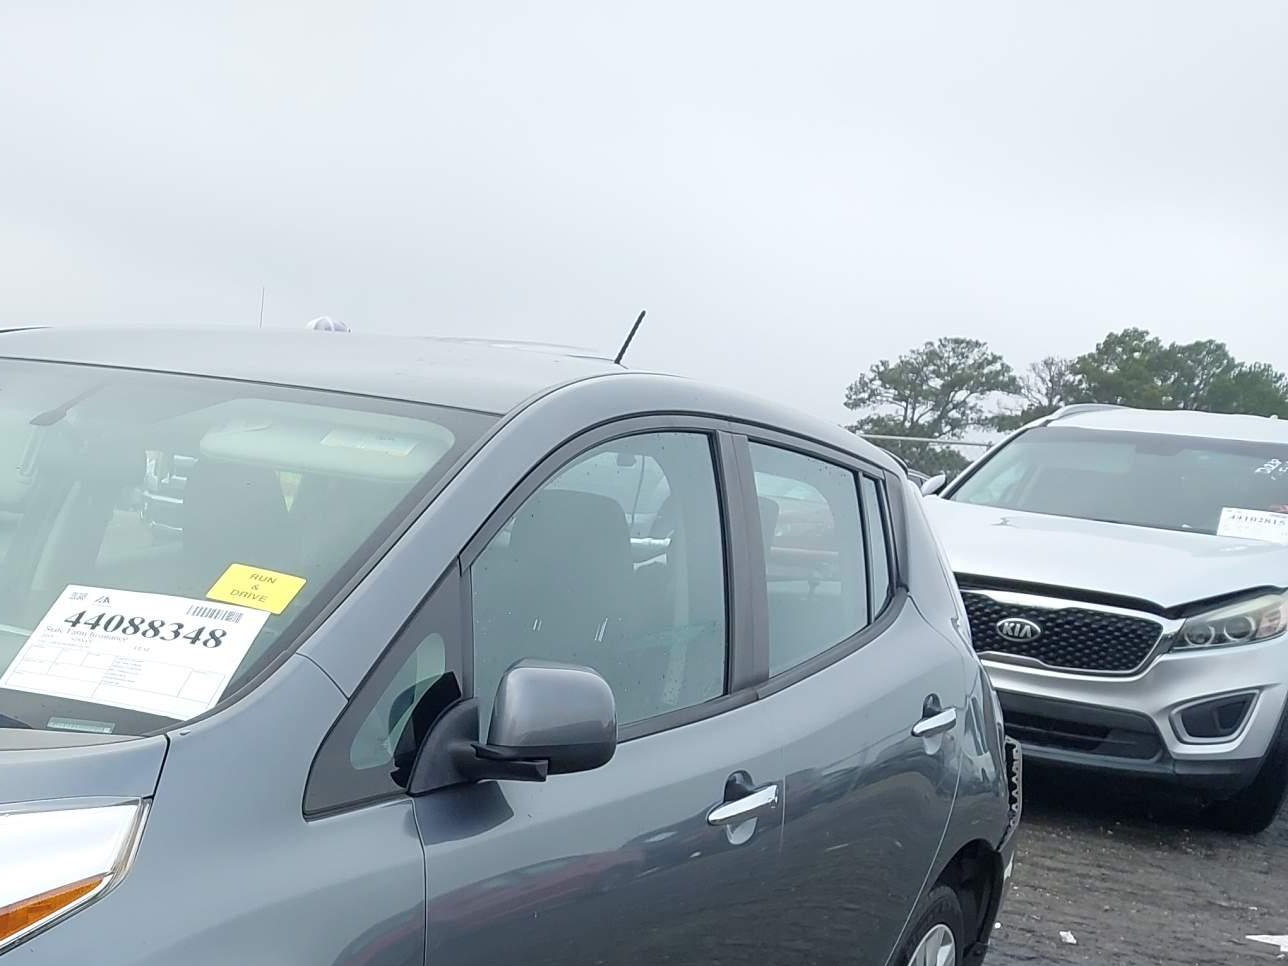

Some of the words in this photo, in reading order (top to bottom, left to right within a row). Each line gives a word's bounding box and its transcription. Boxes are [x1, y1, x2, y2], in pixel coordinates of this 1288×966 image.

[249, 573, 278, 584] RUN
[230, 589, 269, 603] DRIVE
[64, 609, 228, 649] 44088348
[1002, 622, 1032, 639] KIA
